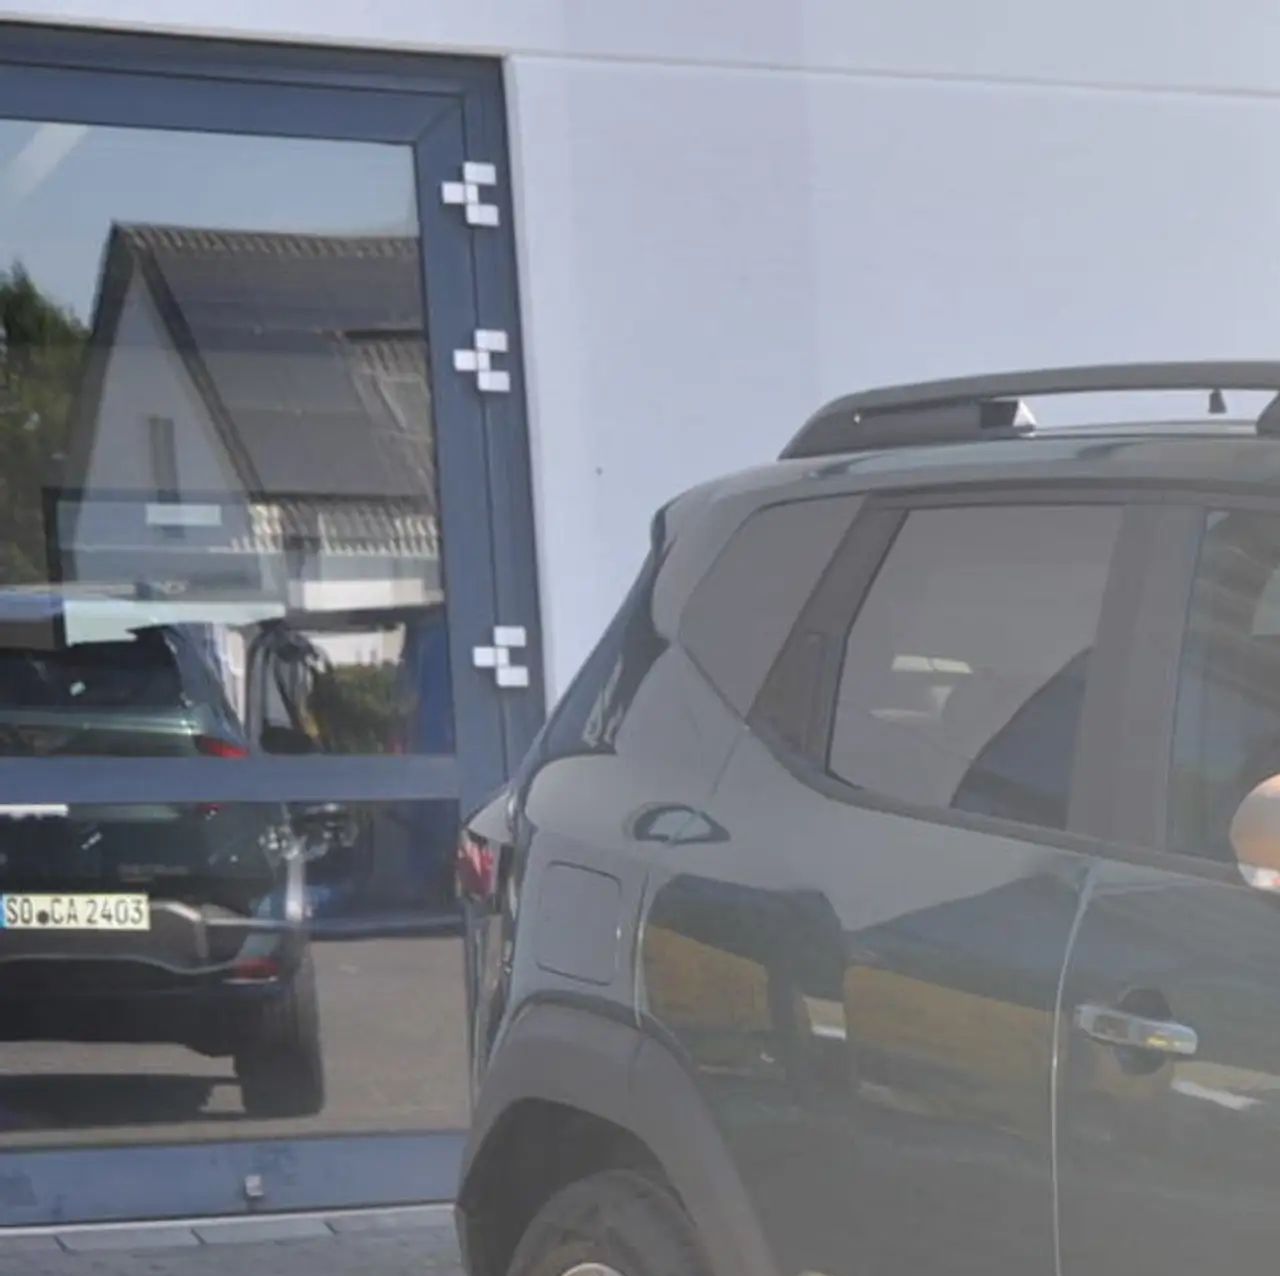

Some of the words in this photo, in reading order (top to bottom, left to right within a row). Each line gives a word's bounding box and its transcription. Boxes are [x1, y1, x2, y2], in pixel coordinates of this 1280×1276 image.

[6, 897, 33, 925] SO
[51, 897, 79, 925] CA
[86, 897, 143, 925] 2403
